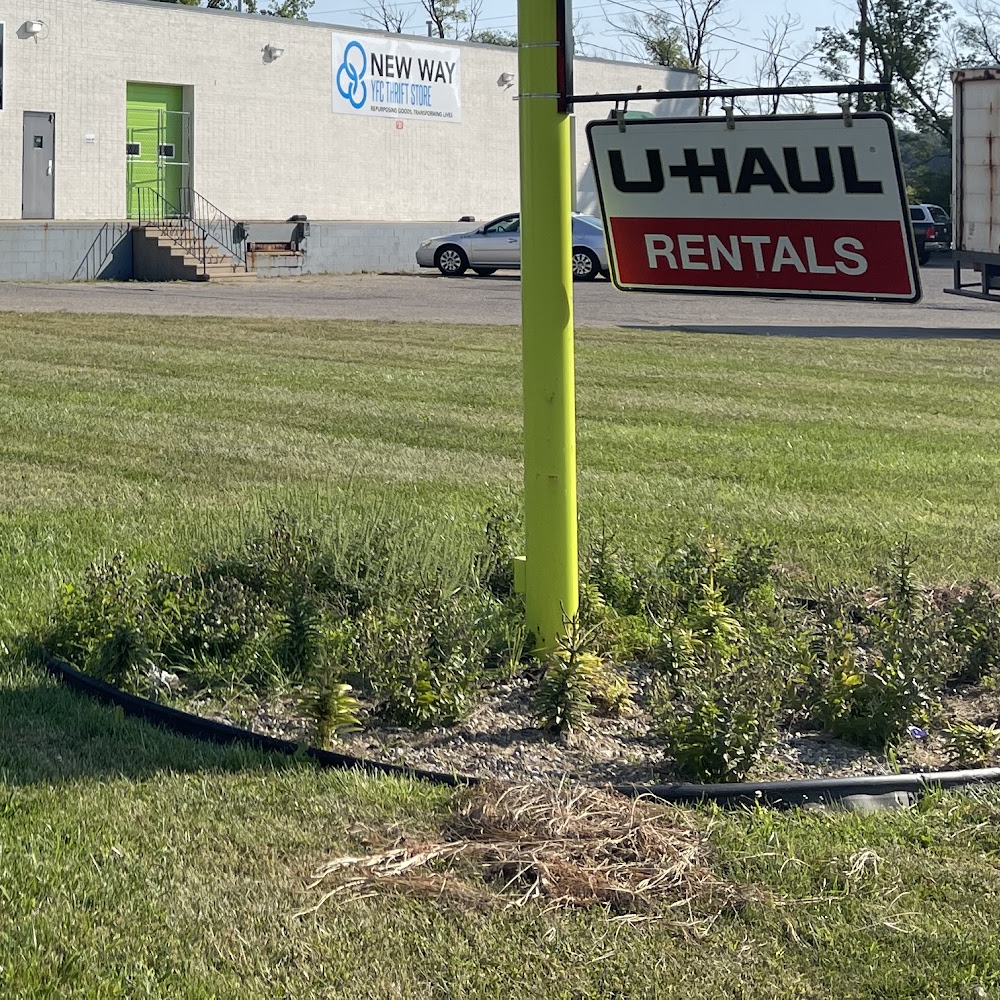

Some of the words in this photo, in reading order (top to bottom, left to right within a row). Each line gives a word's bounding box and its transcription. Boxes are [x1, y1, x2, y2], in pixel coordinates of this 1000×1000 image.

[370, 52, 412, 80] NEW
[417, 58, 456, 84] WAY
[370, 80, 385, 103] YFC
[385, 81, 410, 105] THRIFT
[410, 83, 432, 107] STORE
[607, 145, 884, 194] U-HAUL
[643, 232, 869, 276] RENTALS
